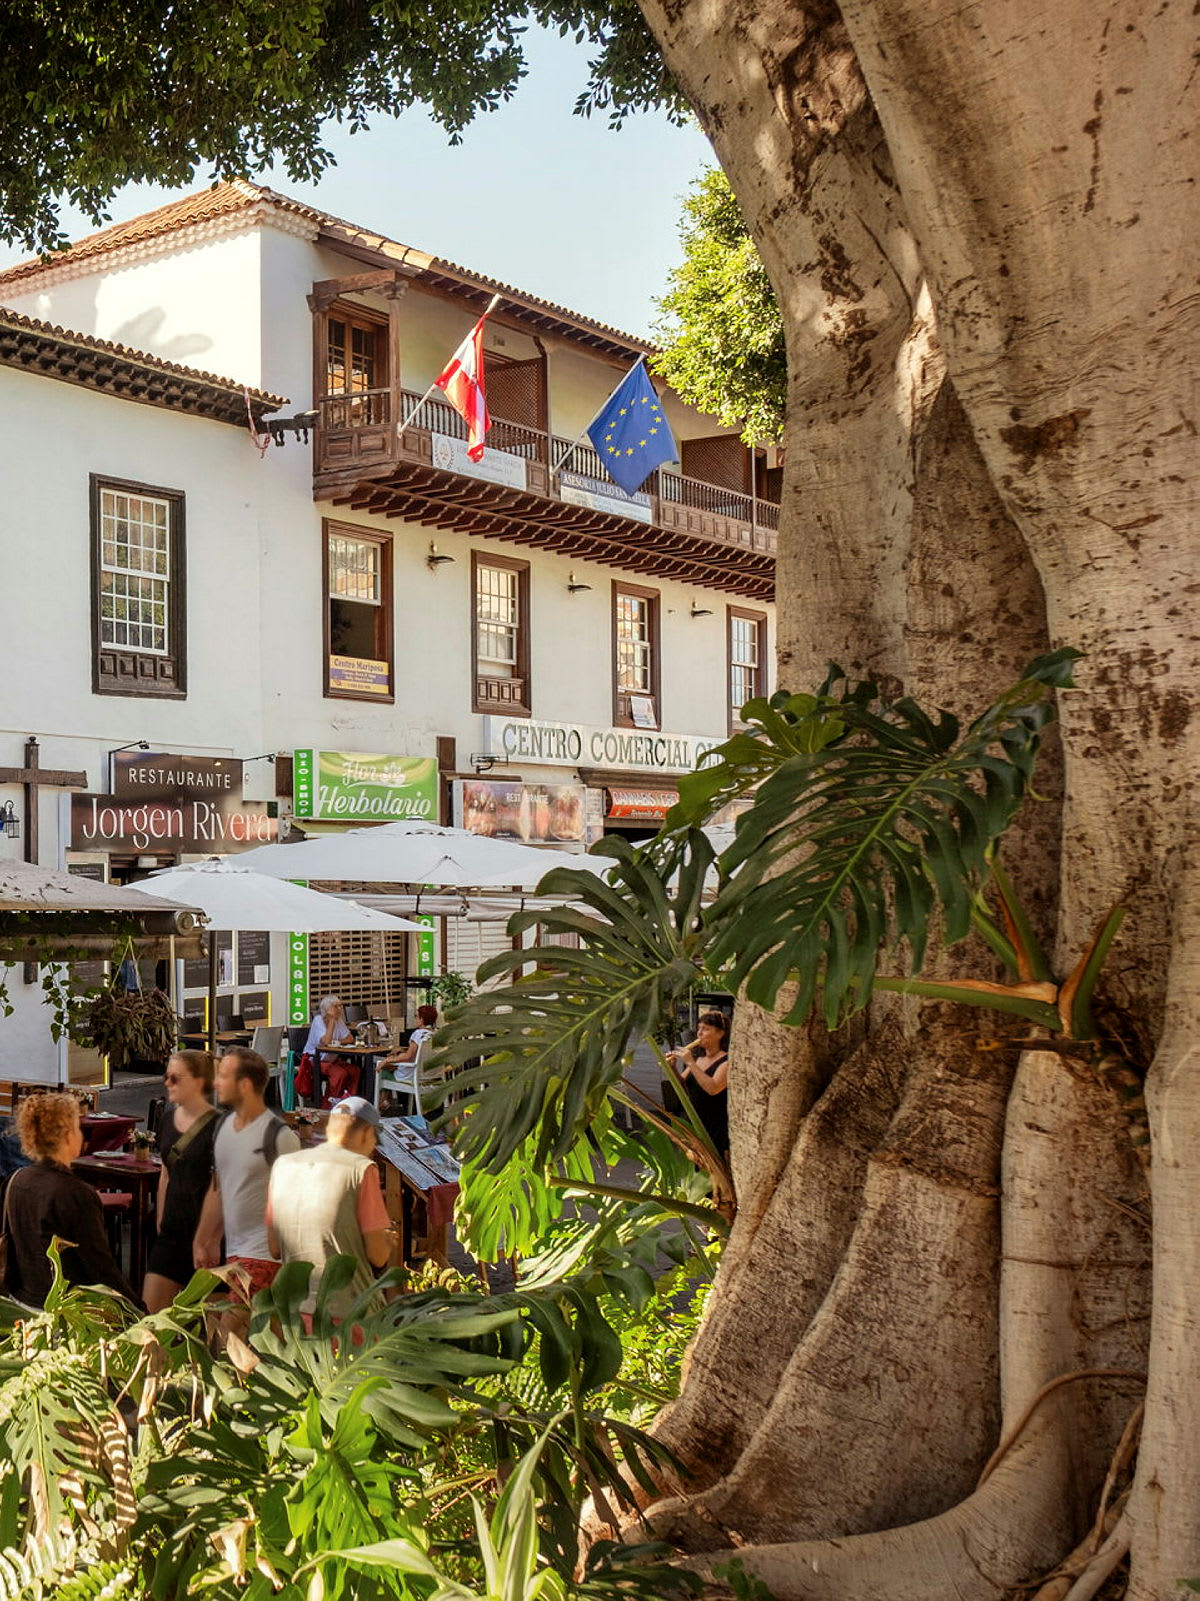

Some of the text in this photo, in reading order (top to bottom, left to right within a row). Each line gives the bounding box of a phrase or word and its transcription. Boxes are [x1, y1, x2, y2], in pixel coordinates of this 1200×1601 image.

[502, 724, 582, 760] CENTRO
[590, 732, 692, 768] COMERCIAL
[128, 767, 232, 789] RESTAURANTE
[318, 784, 432, 816] Herbolario
[82, 797, 273, 849] Jorgen Rivera
